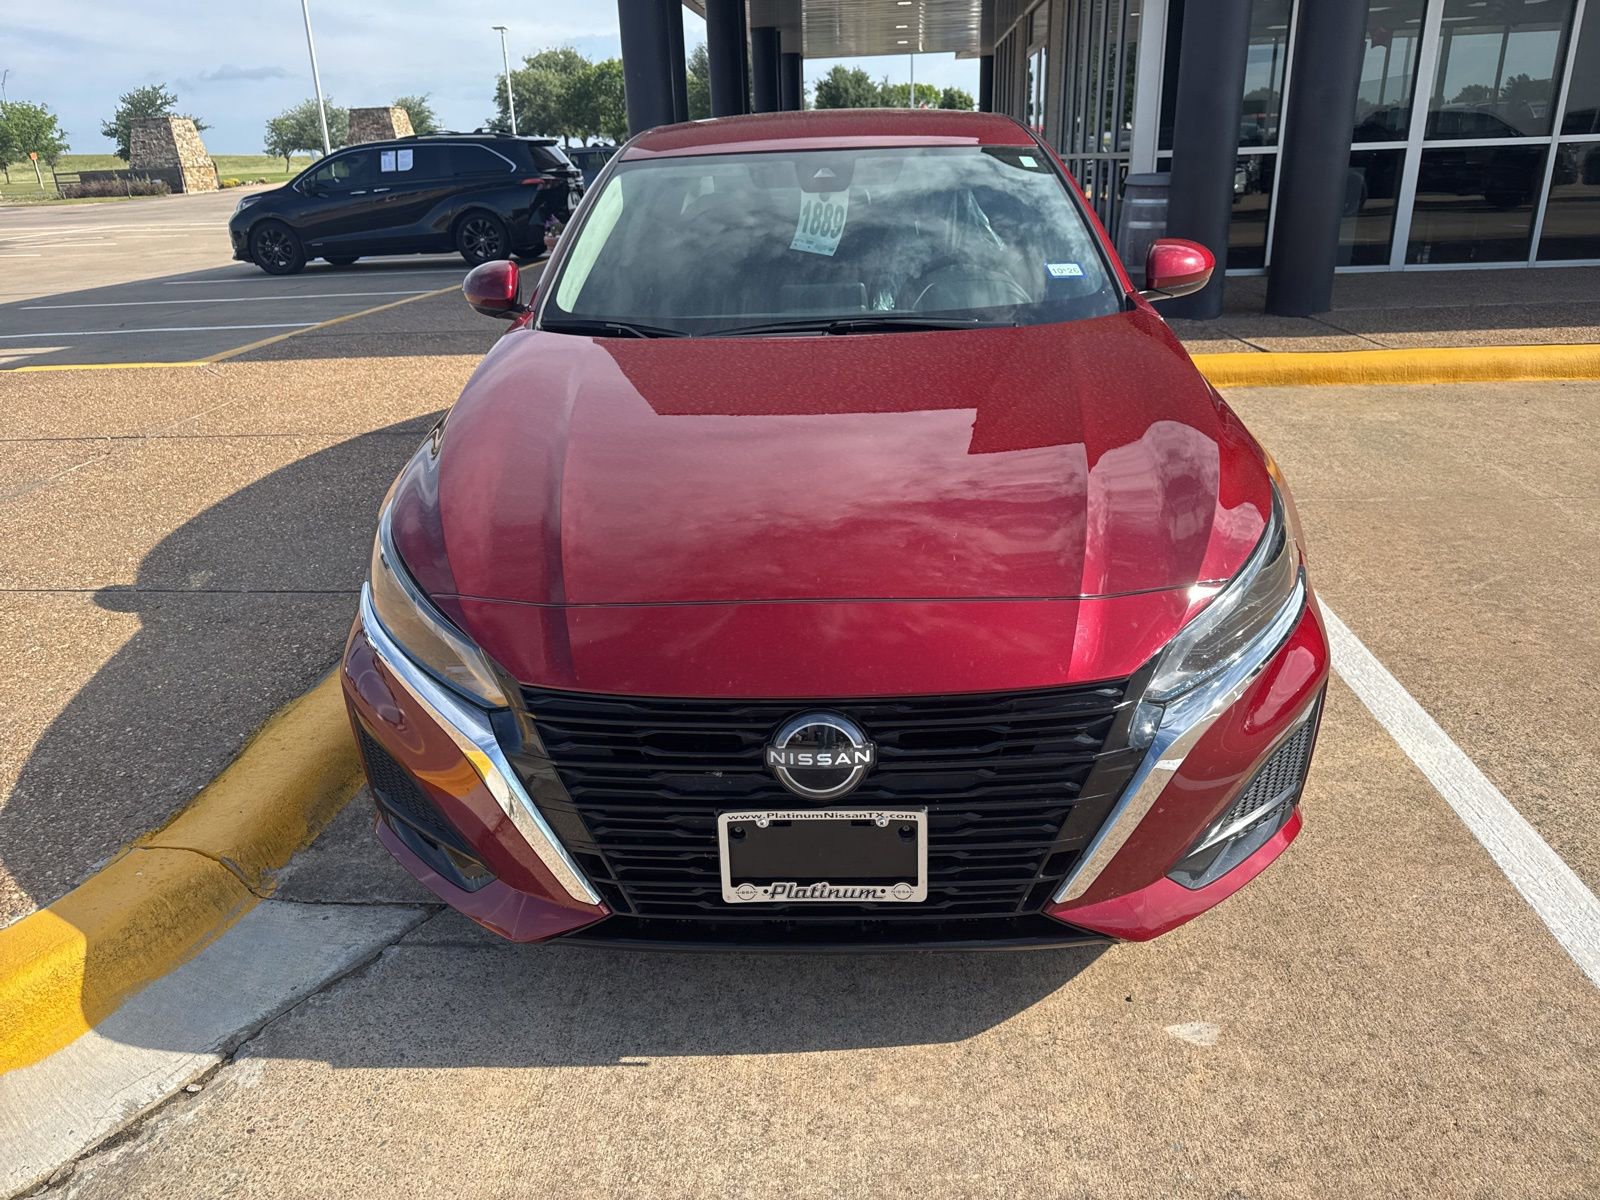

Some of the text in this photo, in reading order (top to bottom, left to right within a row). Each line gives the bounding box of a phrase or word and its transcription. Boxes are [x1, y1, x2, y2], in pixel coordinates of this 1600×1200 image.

[801, 200, 845, 239] 1889
[769, 750, 870, 766] NISSAN
[728, 812, 917, 820] www.PlatinumNissanTX.com
[769, 883, 885, 900] Platinum
